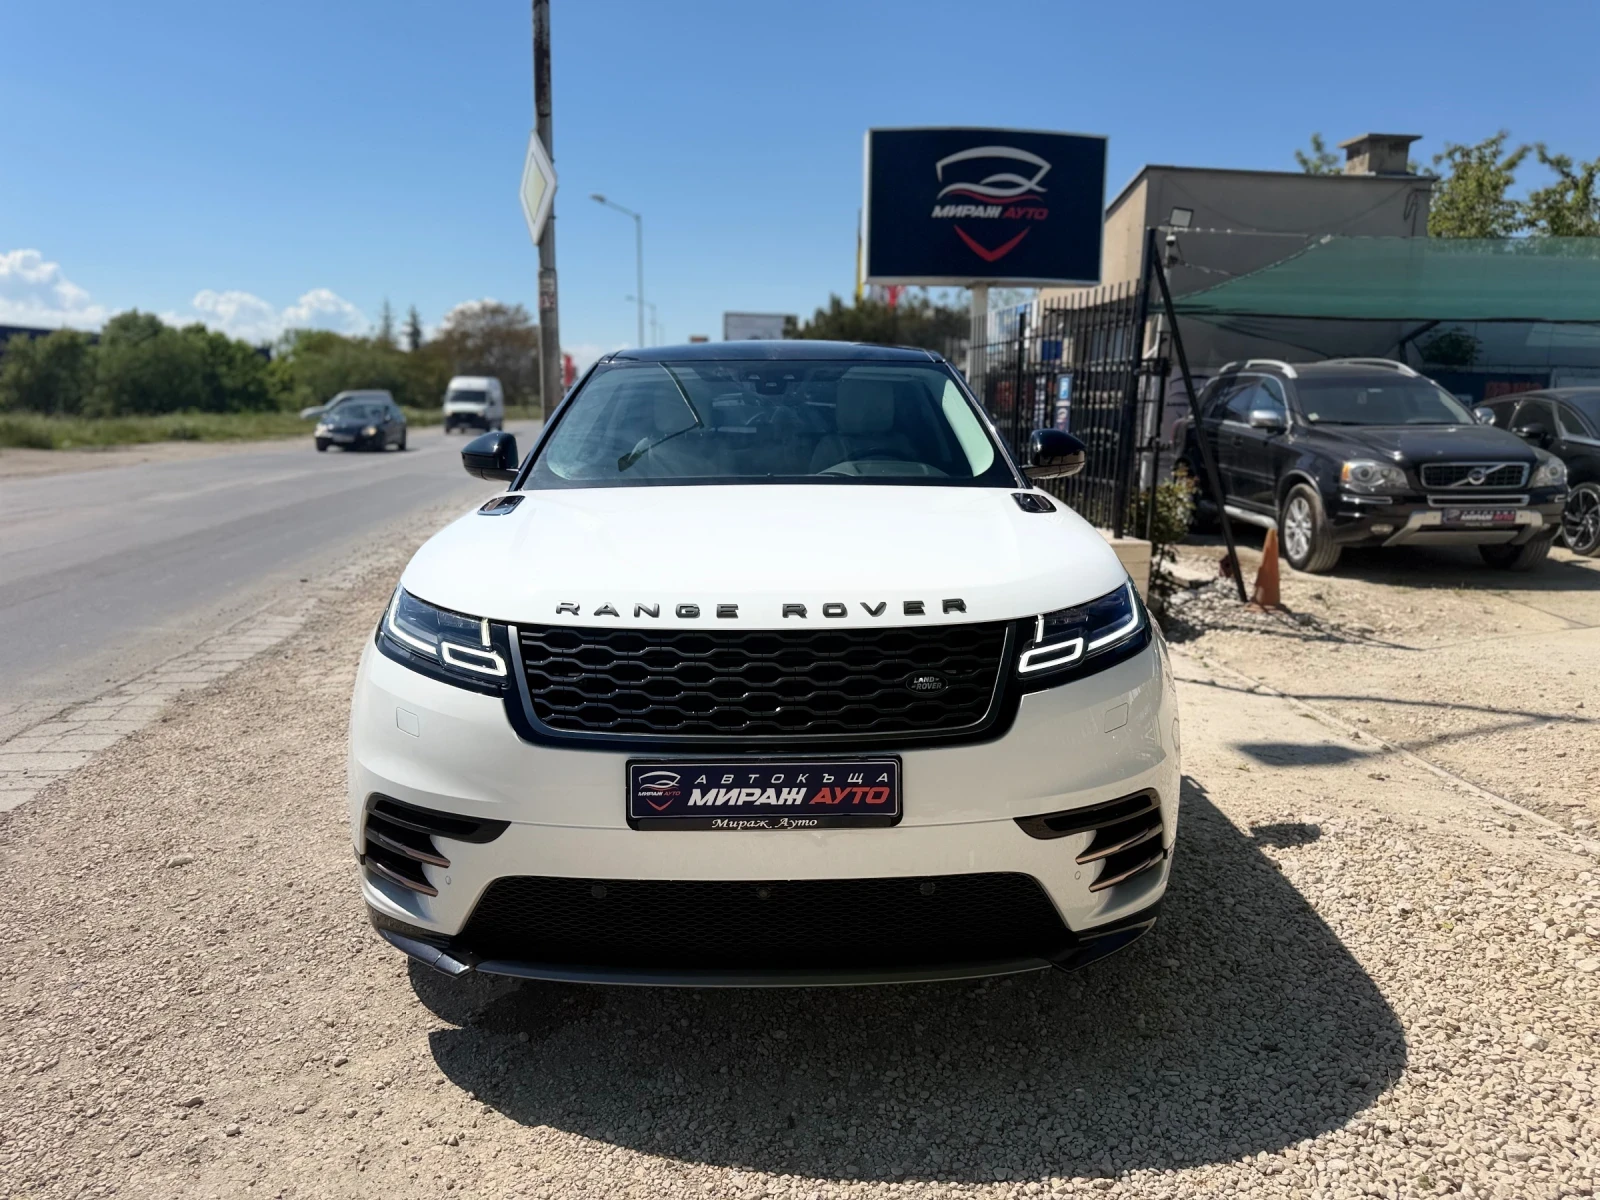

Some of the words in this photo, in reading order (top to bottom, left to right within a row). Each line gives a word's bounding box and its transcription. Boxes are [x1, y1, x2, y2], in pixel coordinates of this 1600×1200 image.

[931, 205, 1002, 219] МИРАЖ
[1003, 206, 1049, 220] АУТО
[555, 600, 739, 619] RANGE
[782, 598, 967, 619] ROVER
[913, 676, 935, 684] LAND
[916, 682, 942, 690] ROVER
[694, 772, 888, 785] АВТОКЪЩА
[687, 787, 807, 806] МИРАЖ
[809, 786, 890, 804] АУТО
[711, 818, 772, 830] Мираж
[774, 817, 818, 830] Ауто
